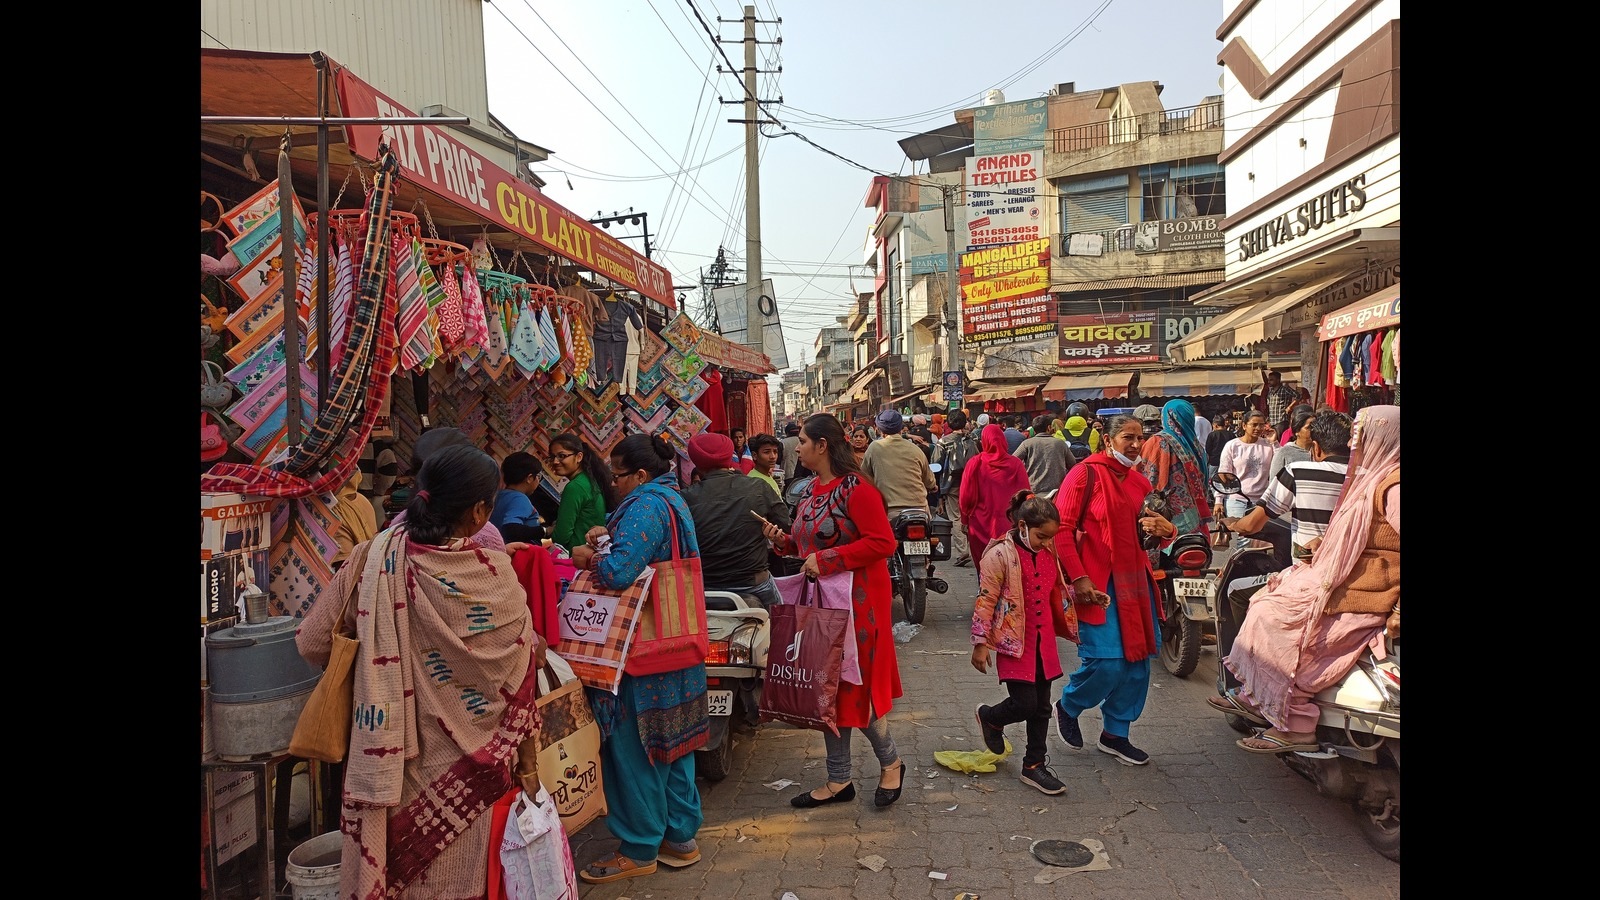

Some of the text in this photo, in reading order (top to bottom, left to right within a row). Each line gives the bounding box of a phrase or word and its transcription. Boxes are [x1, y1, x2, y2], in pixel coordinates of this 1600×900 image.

[375, 96, 490, 211] FIX PRICE
[977, 153, 1032, 172] ANAND
[972, 168, 1037, 186] TEXTILES
[1007, 187, 1035, 195] DRESSES
[971, 196, 1035, 207] SAREES LEHANGA
[986, 207, 1005, 215] MEN'S
[1239, 173, 1367, 262] SHIVA SUITS
[496, 181, 594, 265] GULATI
[971, 226, 1039, 237] 9416958059
[1163, 218, 1219, 234] BOMB
[971, 233, 1039, 245] 8950514406
[1173, 233, 1201, 241] CLOTH
[962, 238, 1050, 267] MANGALDEEP
[596, 252, 637, 286] ENTERPRISES
[916, 258, 944, 268] PARAS
[973, 255, 1039, 278] DESIGNER
[971, 272, 1040, 299] Only Wholesale
[964, 294, 1052, 315] KURTI SUITS LEHANGA
[970, 305, 1047, 323] DESIGNER DRESSES
[1357, 302, 1392, 328] कृपा
[976, 316, 1041, 331] PRINTED FABRIC
[1063, 322, 1153, 342] चावला
[1015, 334, 1033, 342] GIRLS
[1034, 331, 1057, 339] HOSTEL
[1064, 343, 1110, 358] पगड़ी
[217, 502, 266, 519] GALAXY
[211, 569, 219, 613] MACHO
[584, 607, 608, 626] राधे
[771, 663, 813, 682] DISHU
[770, 678, 792, 686] ETHNIC
[709, 695, 727, 704] 1AH
[709, 705, 727, 714] 22
[241, 772, 257, 784] PLUS
[571, 761, 597, 794] राधे
[564, 796, 584, 812] SAREES
[231, 830, 248, 845] PLUS
